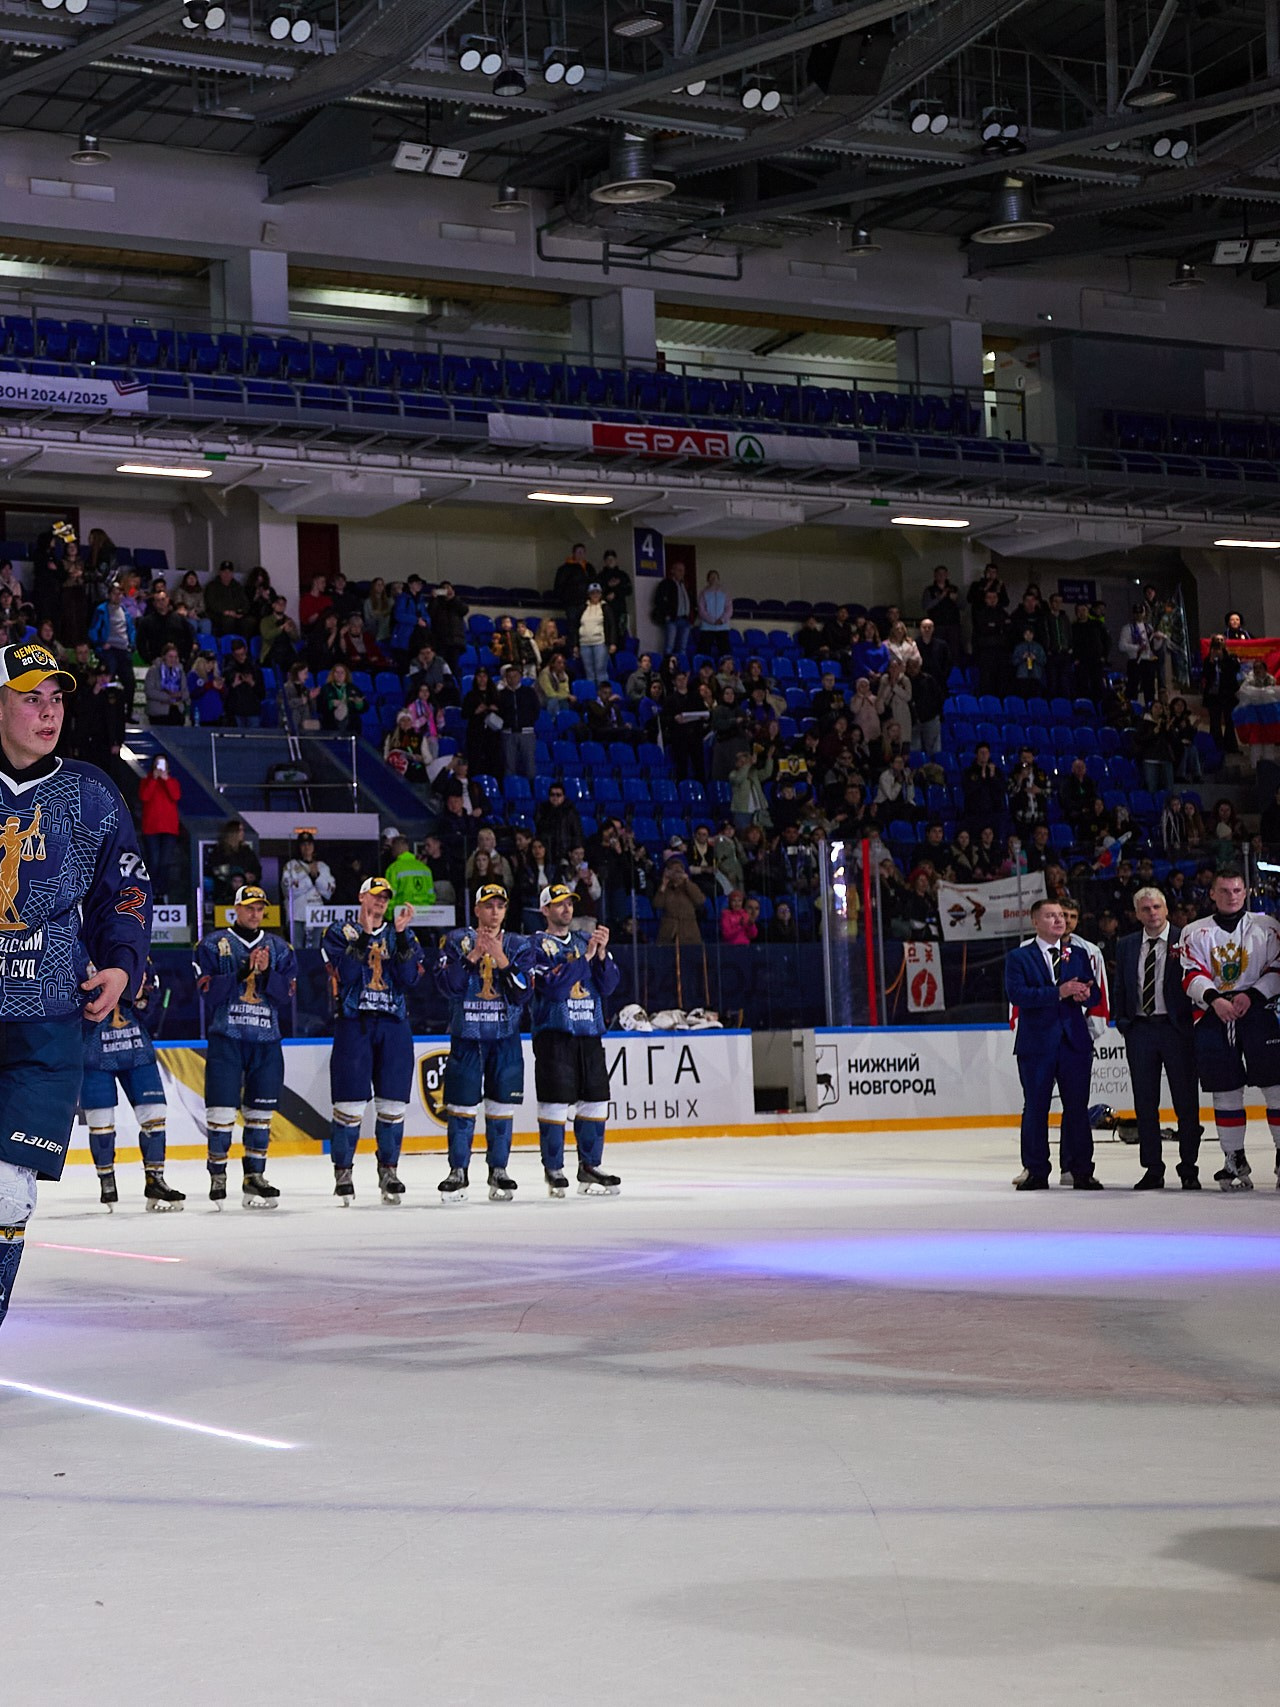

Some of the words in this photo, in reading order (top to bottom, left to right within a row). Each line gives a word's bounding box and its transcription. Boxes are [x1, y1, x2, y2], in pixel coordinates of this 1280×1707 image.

[31, 389, 108, 405] 2024/2025
[624, 431, 727, 457] SPAR
[642, 533, 655, 558] 4
[11, 959, 36, 980] СУД
[848, 1053, 920, 1074] НИЖНИЙ
[1092, 1047, 1126, 1060] АВИТ
[601, 1045, 701, 1086] ИГА
[1091, 1066, 1128, 1079] ЖЕГОР
[849, 1079, 936, 1096] НОВГОРОД
[1091, 1082, 1128, 1094] ЛАСТИ
[606, 1099, 699, 1121] ЛЬНЫХ
[10, 1131, 63, 1156] BAUER
